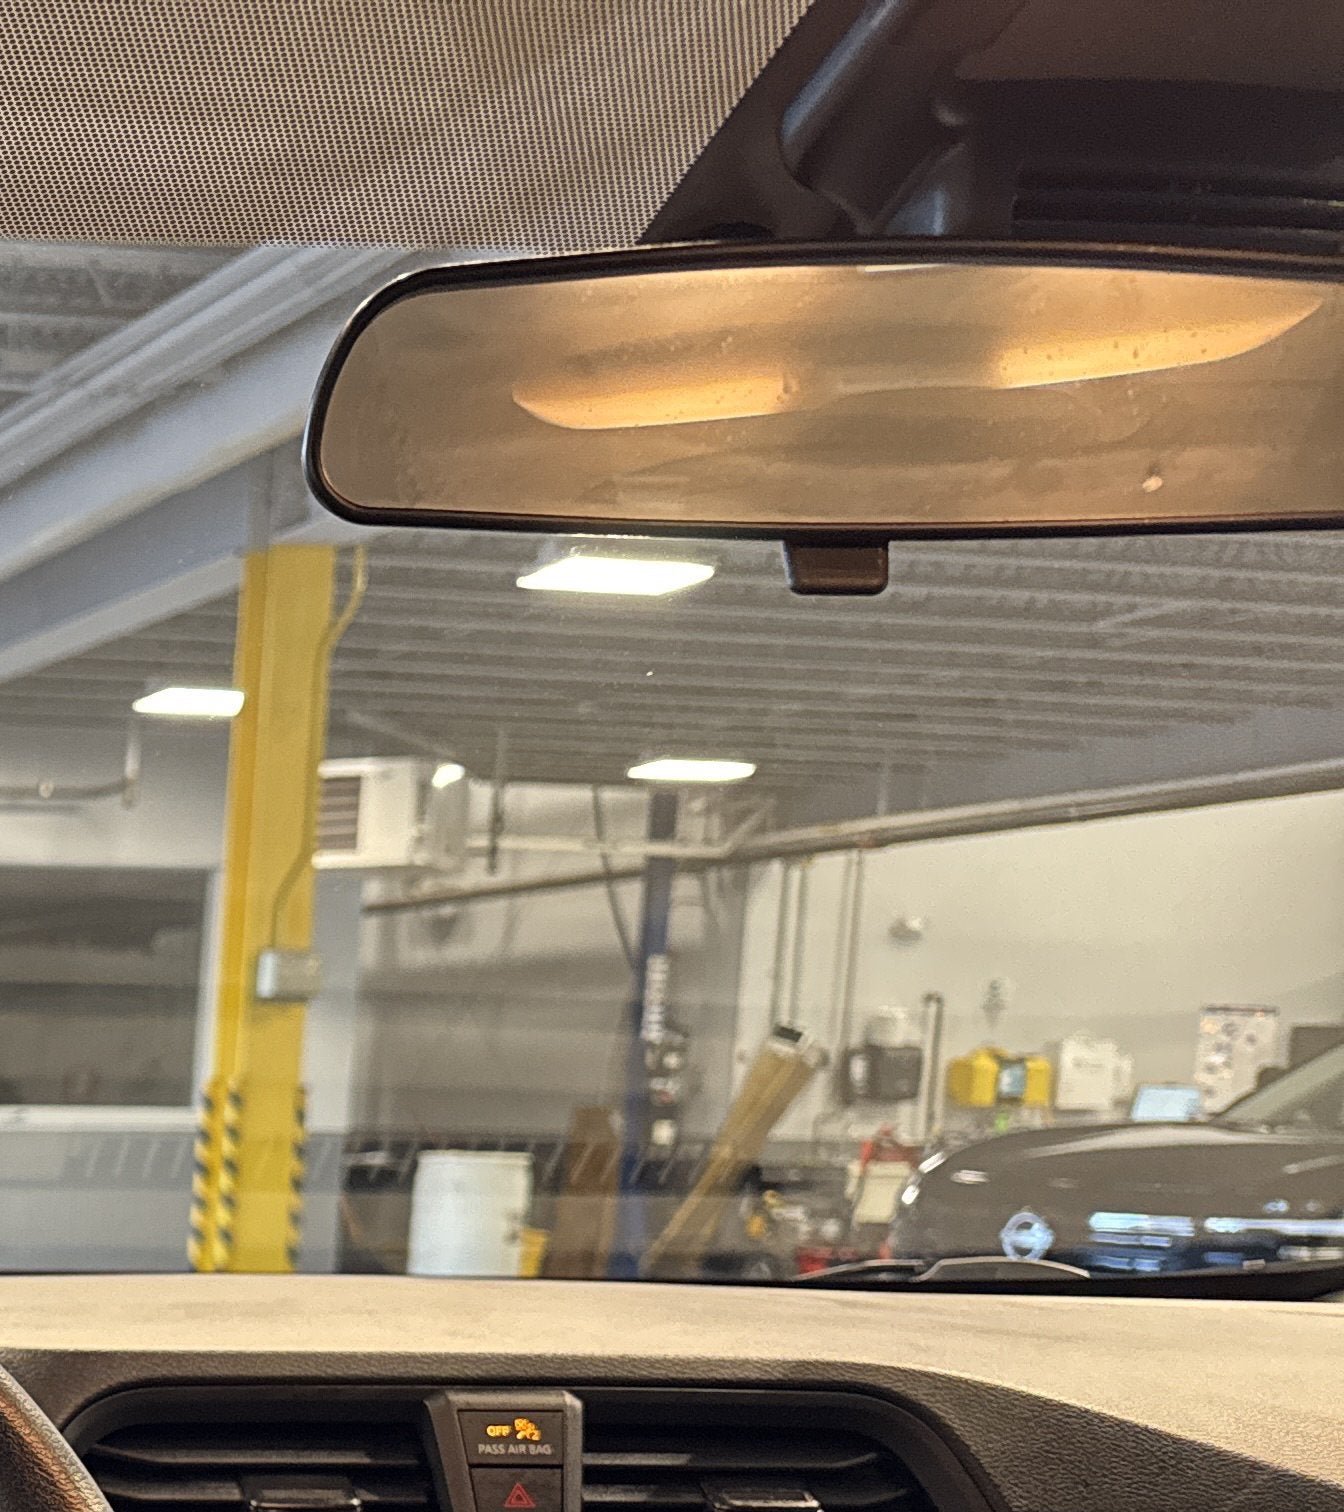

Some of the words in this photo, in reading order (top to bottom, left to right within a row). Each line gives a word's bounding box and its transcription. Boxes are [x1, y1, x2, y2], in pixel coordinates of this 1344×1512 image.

[486, 1425, 511, 1438] OFF
[477, 1443, 505, 1455] PASS
[507, 1443, 527, 1455] AIR
[528, 1443, 552, 1456] BAG
